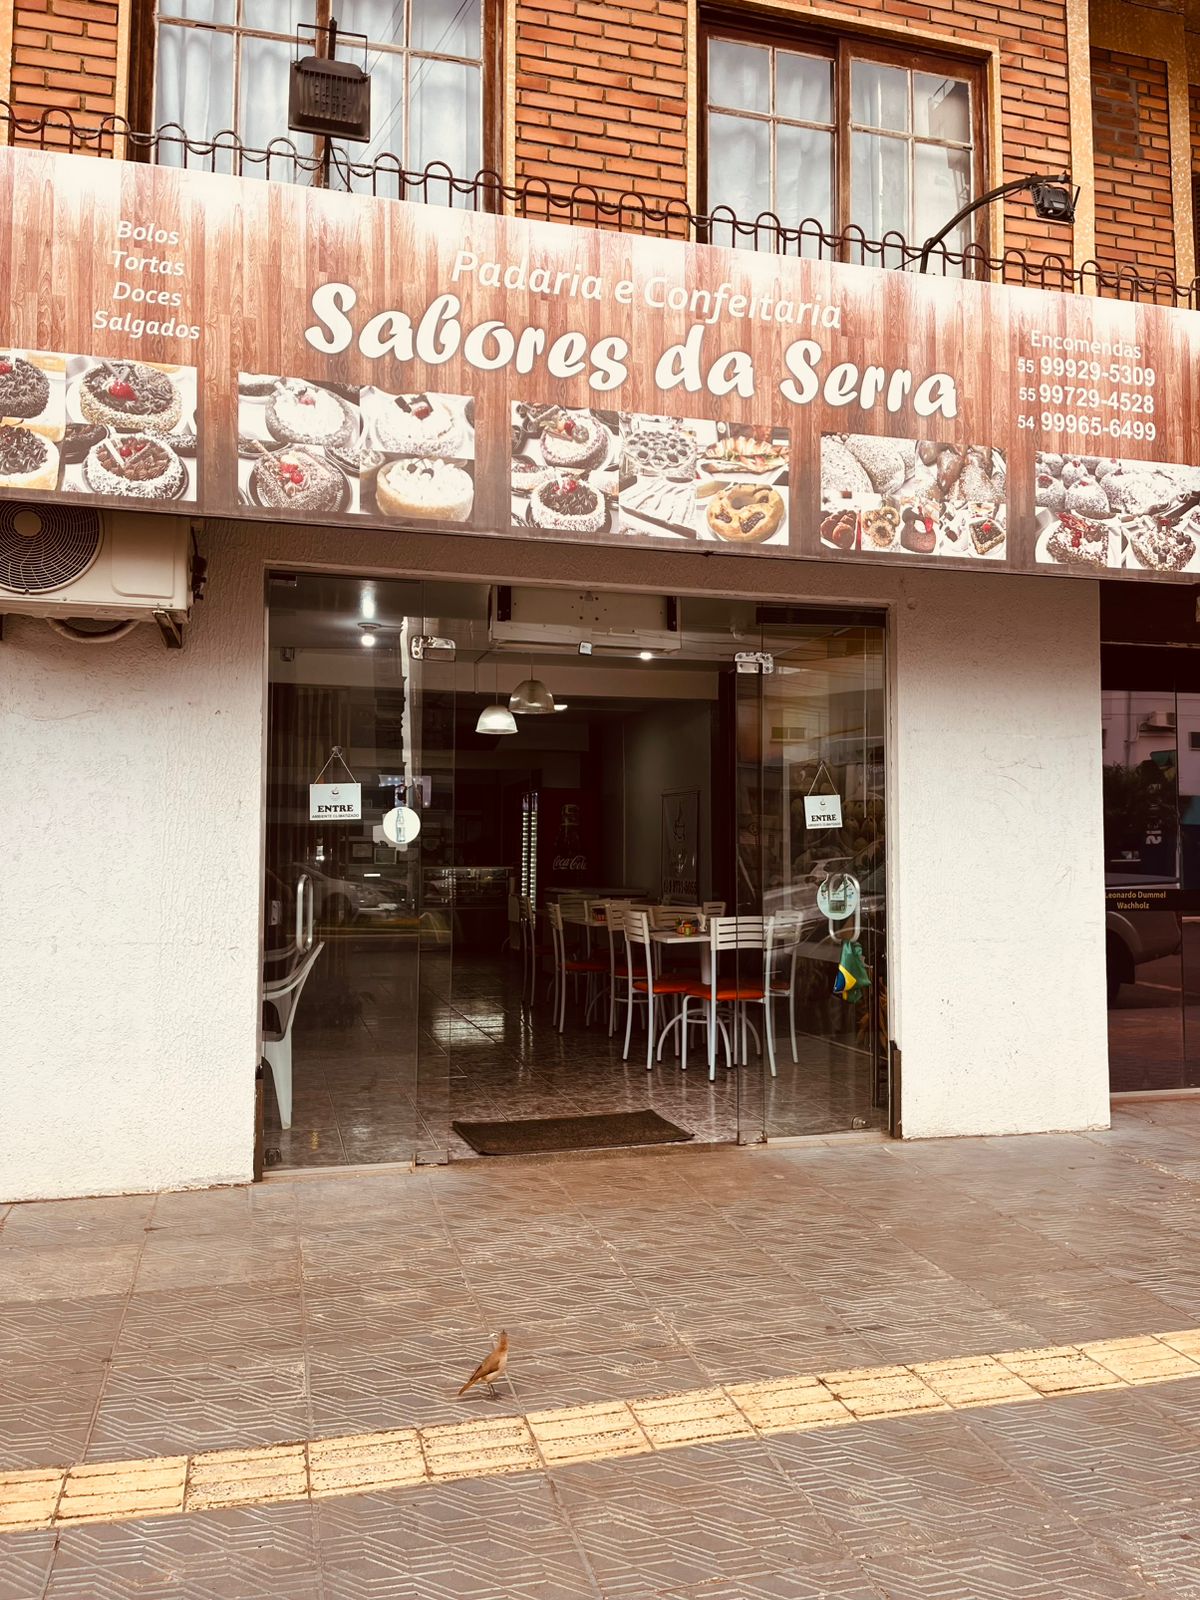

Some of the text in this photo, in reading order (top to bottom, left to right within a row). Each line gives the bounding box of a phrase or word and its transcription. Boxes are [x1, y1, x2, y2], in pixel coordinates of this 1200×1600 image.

[117, 220, 180, 245] Bolos
[111, 250, 185, 276] Tortas
[112, 281, 182, 306] Doces
[451, 250, 843, 330] Padaria e Confeitaria
[92, 310, 201, 340] Salgados
[304, 281, 960, 420] Sabores da Serra
[1030, 329, 1142, 360] Encomendas
[1017, 356, 1156, 387] 55 99929-5309
[1019, 383, 1155, 415] 55 99729-4528
[1017, 411, 1156, 442] 54 99965-6499
[317, 804, 354, 813] ENTRE
[811, 813, 837, 822] ENTRE
[1116, 901, 1150, 910] Wachholz
[1137, 891, 1167, 899] Dummel
